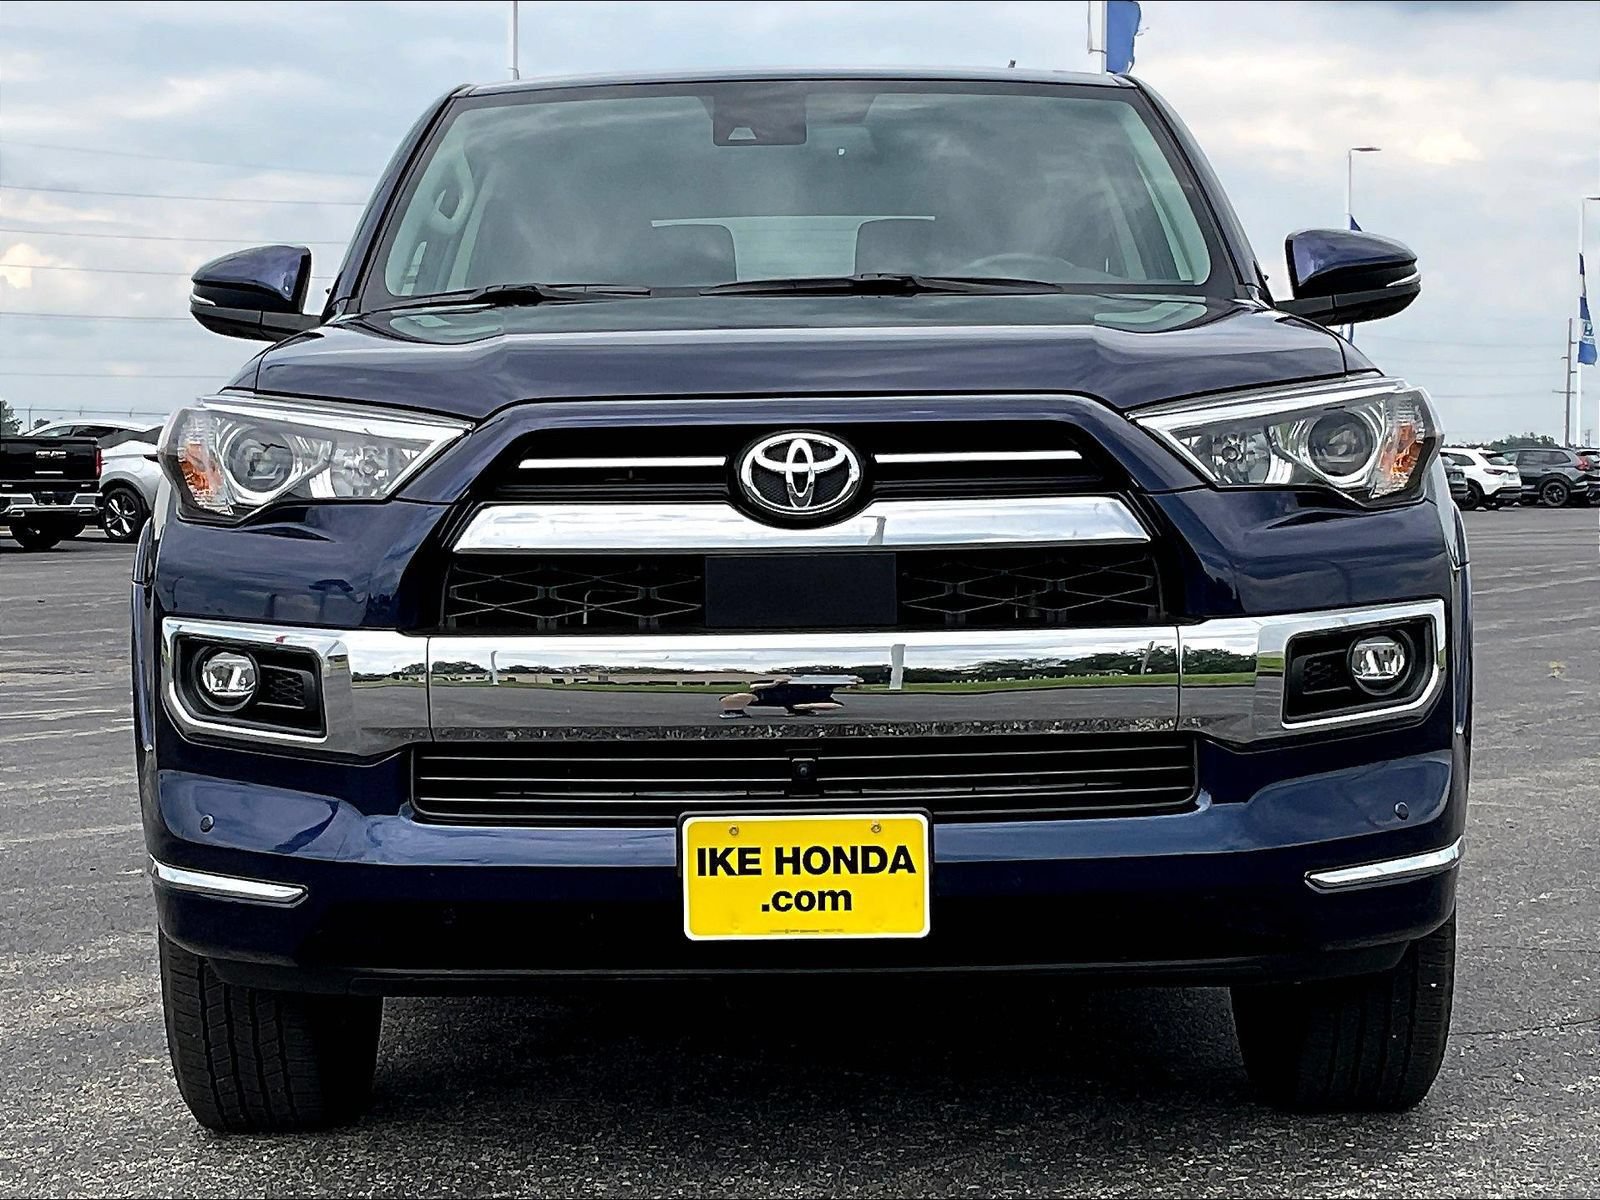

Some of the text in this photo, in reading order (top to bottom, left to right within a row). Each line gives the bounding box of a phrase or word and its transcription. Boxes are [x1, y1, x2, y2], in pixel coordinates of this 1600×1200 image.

[697, 845, 917, 877] IKE HONDA
[761, 889, 852, 912] .com
